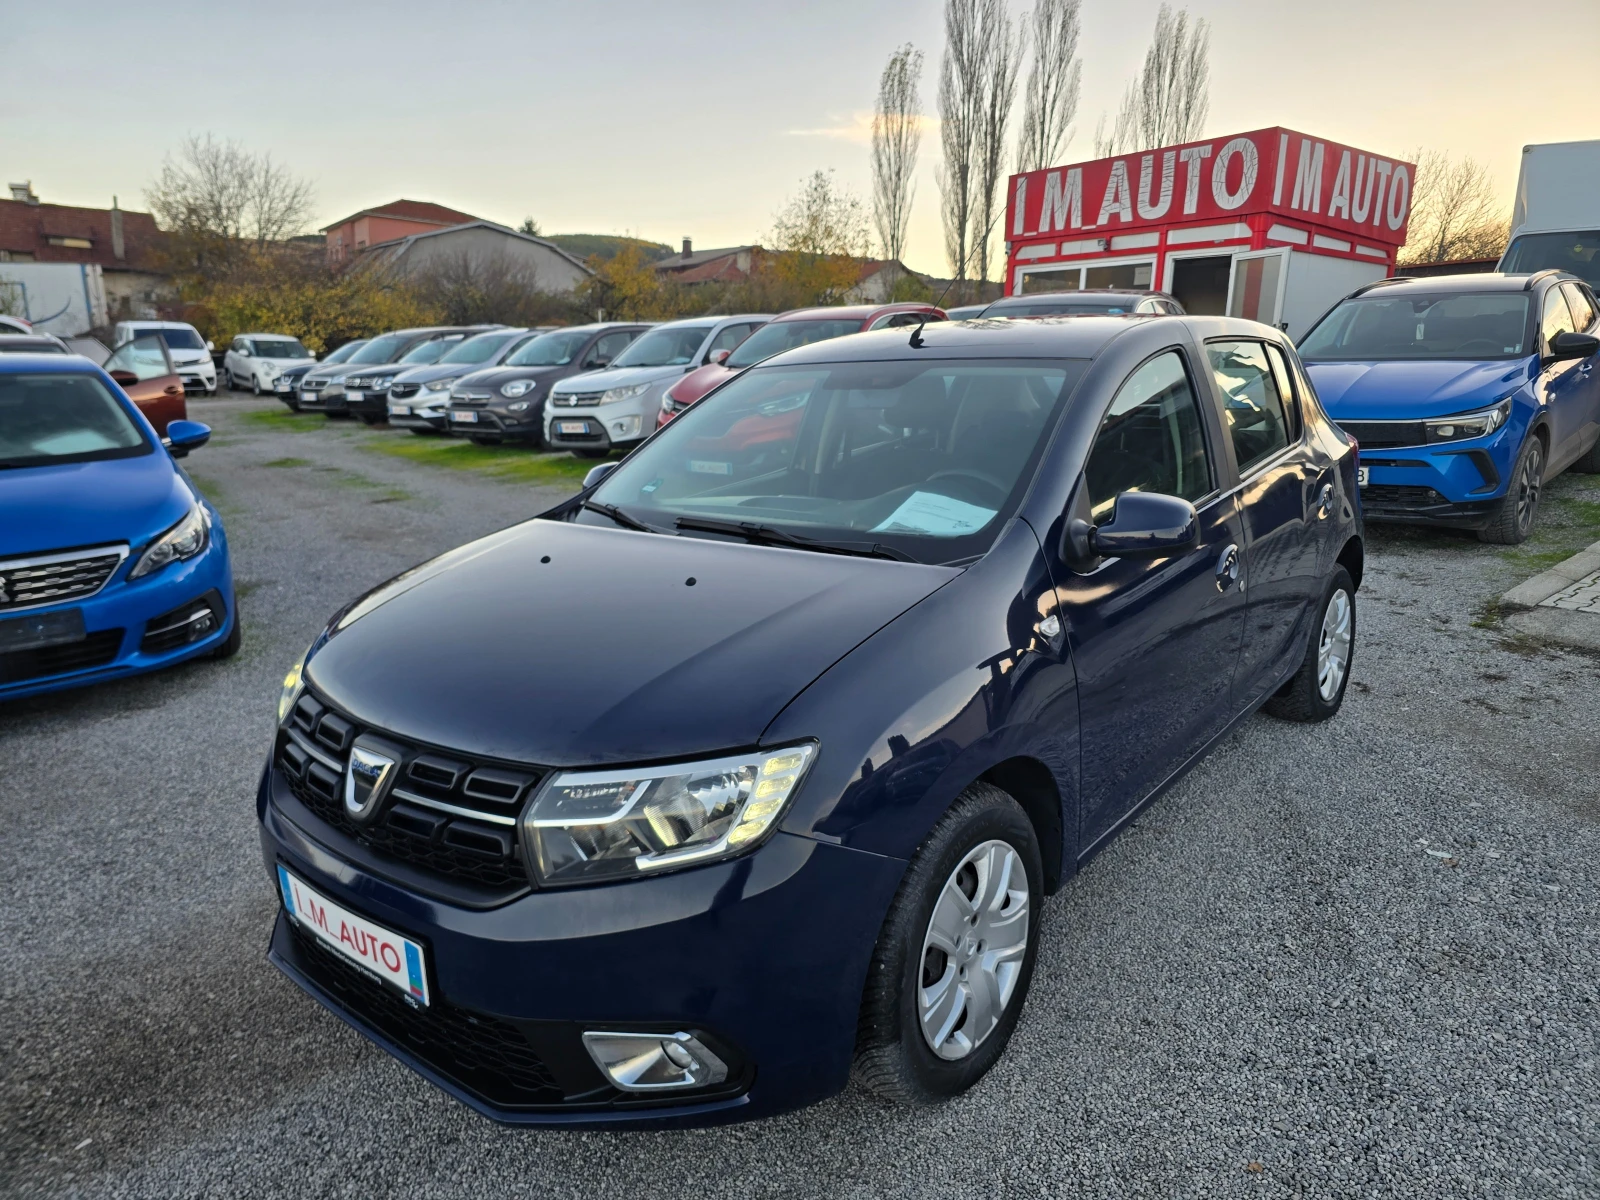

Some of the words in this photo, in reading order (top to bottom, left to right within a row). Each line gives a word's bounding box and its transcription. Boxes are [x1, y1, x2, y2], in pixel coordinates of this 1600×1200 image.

[1272, 133, 1289, 206] I
[1291, 138, 1325, 214] M
[1327, 150, 1409, 231] AUTO
